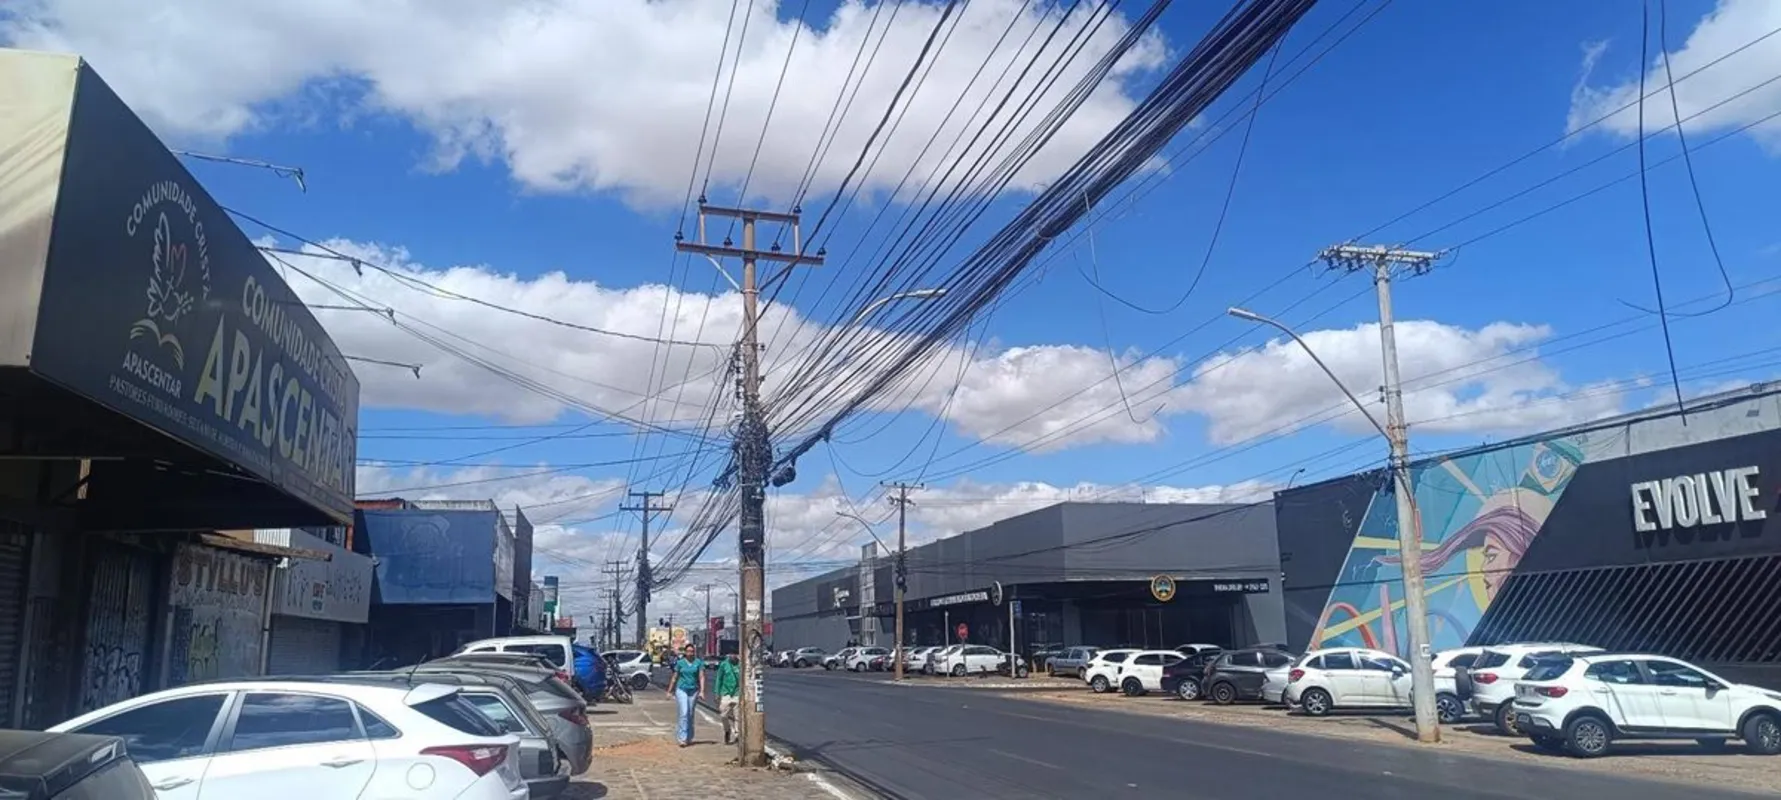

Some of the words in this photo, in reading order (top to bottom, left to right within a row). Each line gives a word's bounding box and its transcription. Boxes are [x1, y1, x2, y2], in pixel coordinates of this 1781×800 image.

[127, 180, 197, 237] COMUNIDADE
[242, 275, 321, 383] COMUNIDADE
[122, 349, 182, 399] APASCENTAR
[194, 312, 355, 499] APASCENTAR
[1631, 465, 1768, 533] EVOLVE
